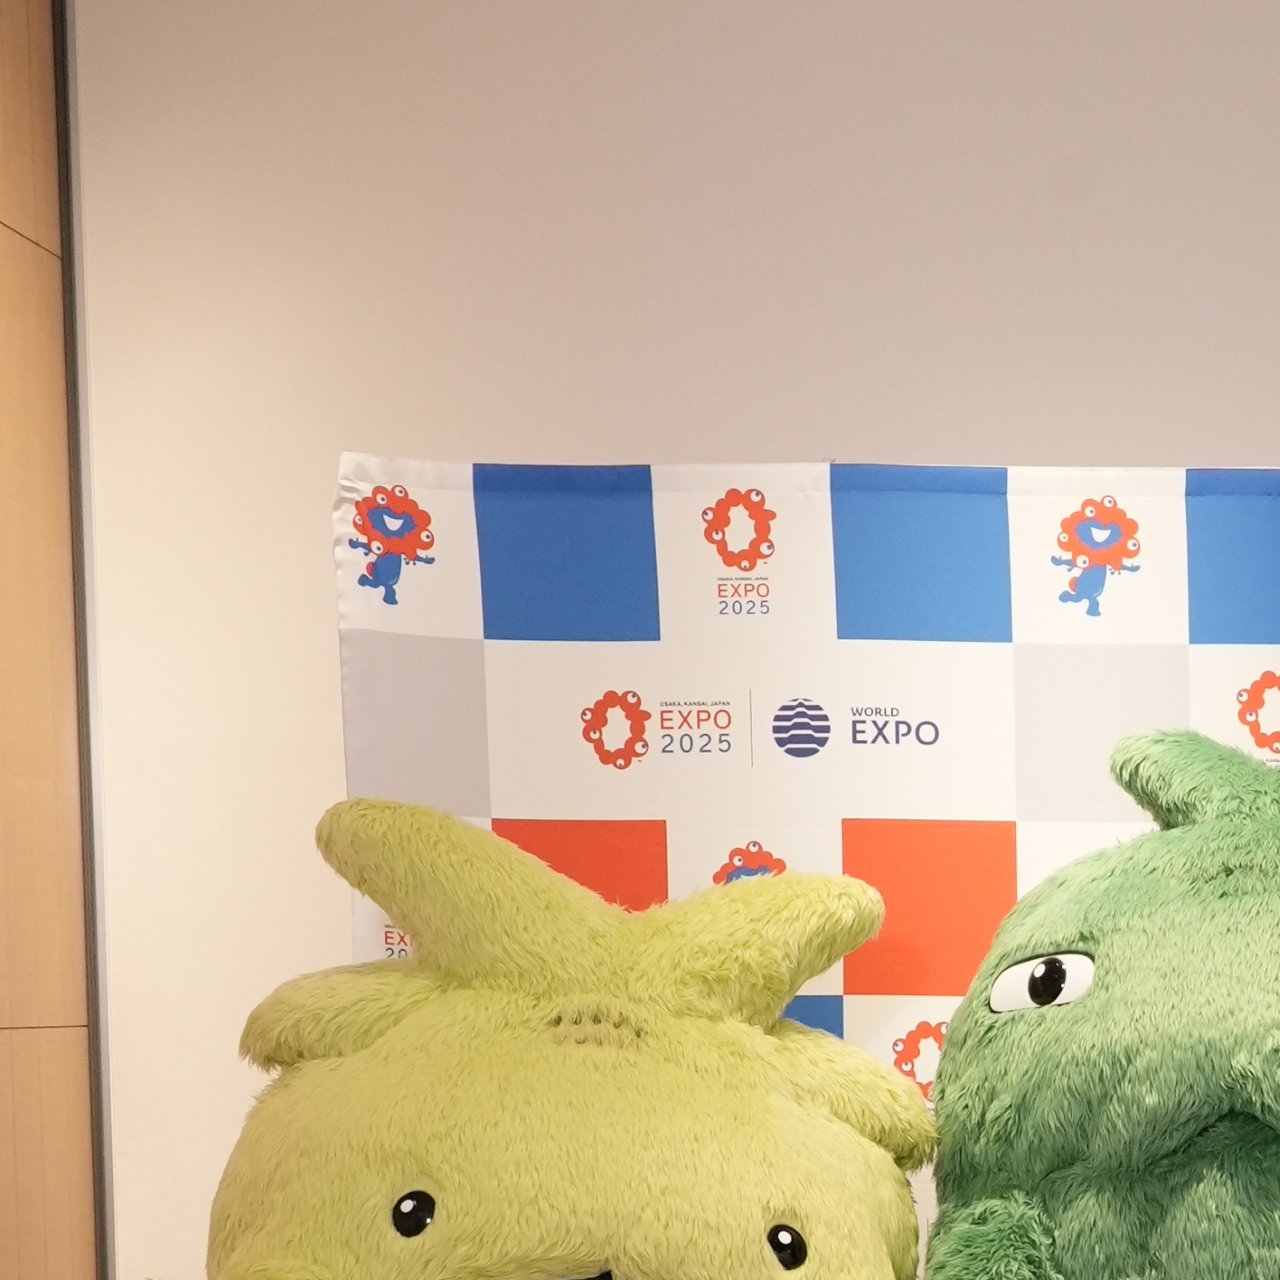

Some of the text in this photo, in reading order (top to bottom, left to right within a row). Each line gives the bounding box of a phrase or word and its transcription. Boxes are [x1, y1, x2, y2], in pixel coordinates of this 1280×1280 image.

[717, 582, 770, 598] EXPO
[718, 599, 770, 615] 2025
[659, 709, 732, 730] EXPO
[850, 706, 900, 717] WORLD
[851, 719, 940, 746] EXPO
[661, 733, 732, 753] 2025
[384, 930, 413, 947] EX
